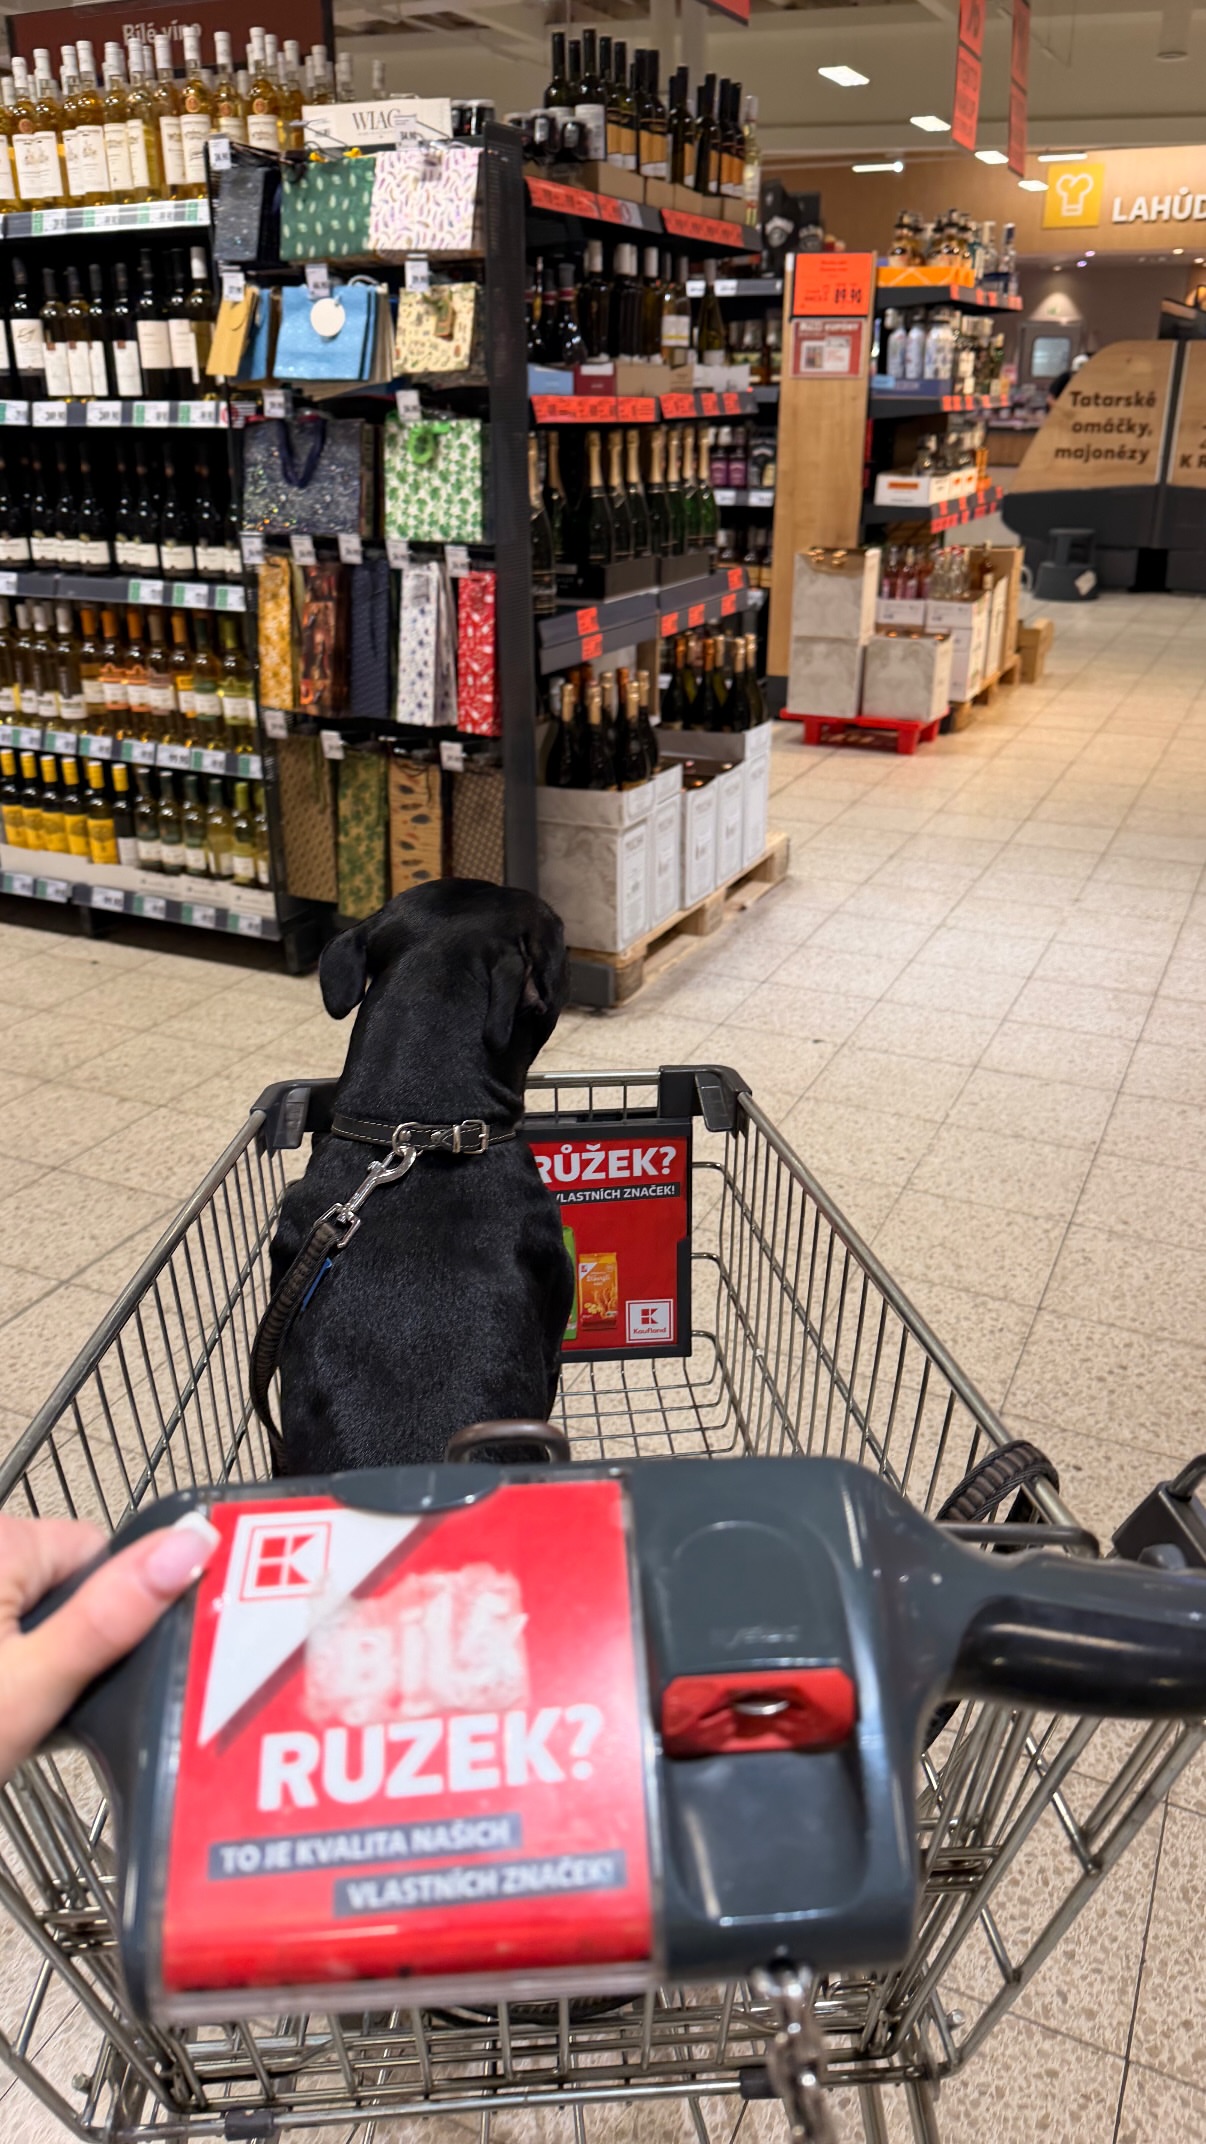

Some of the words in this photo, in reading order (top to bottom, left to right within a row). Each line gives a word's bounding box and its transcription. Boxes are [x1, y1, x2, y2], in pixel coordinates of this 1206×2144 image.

[1069, 391, 1156, 408] Tatarské
[1072, 418, 1153, 438] omáčky,
[1054, 444, 1150, 465] majonézy
[623, 1184, 675, 1199] ZNAČEK!
[633, 1326, 667, 1335] Kaufland
[220, 1844, 261, 1874] TO
[295, 1829, 408, 1866] KVALITA
